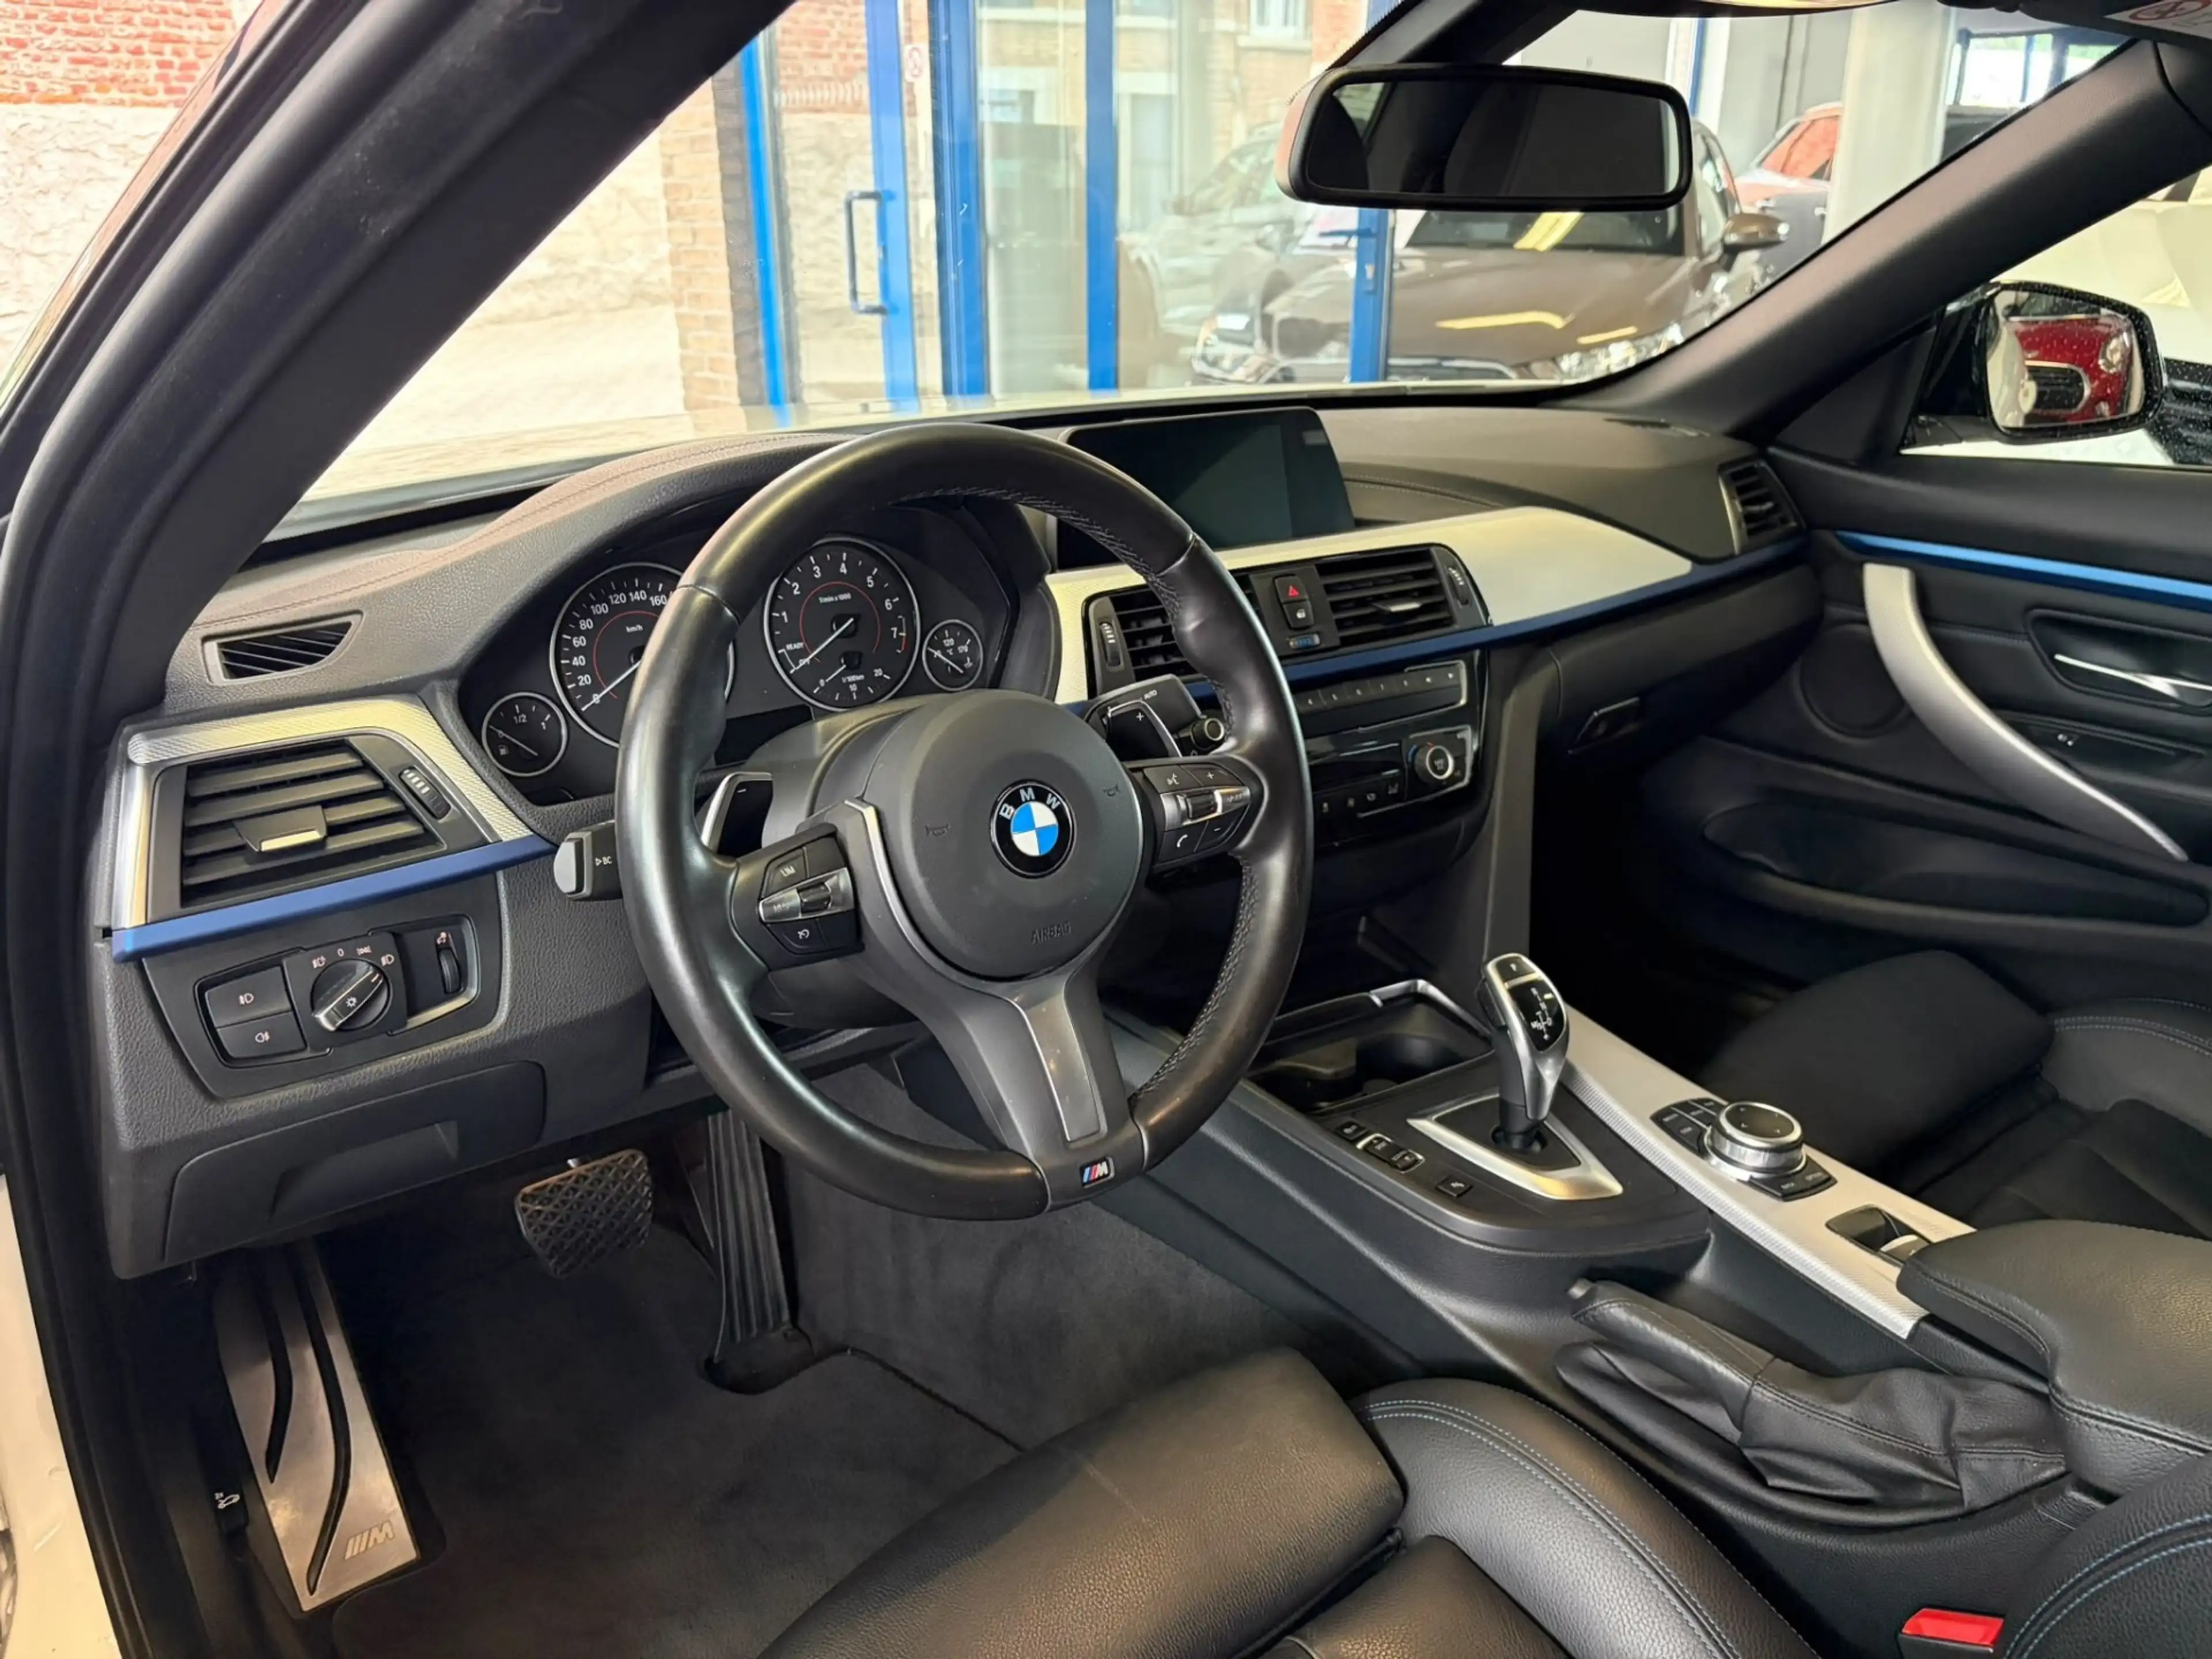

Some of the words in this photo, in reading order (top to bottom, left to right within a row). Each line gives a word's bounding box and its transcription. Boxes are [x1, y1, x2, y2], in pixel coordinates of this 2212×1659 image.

[813, 565, 822, 578] 3
[839, 562, 848, 575] 4
[866, 575, 874, 588] 5
[791, 582, 801, 595] 2
[609, 593, 627, 605] 120
[628, 589, 647, 603] 140
[649, 594, 667, 607] 160
[590, 603, 609, 615] 100
[884, 598, 893, 611] 6
[781, 611, 789, 623] 1
[579, 618, 594, 630] 80
[891, 627, 898, 639] 7
[572, 636, 586, 648] 60
[572, 655, 586, 666] 40
[873, 668, 884, 677] 20
[577, 674, 592, 687] 20
[819, 679, 825, 687] 0
[999, 786, 1061, 820] BMW
[603, 855, 613, 865] BC
[337, 947, 345, 957] 0
